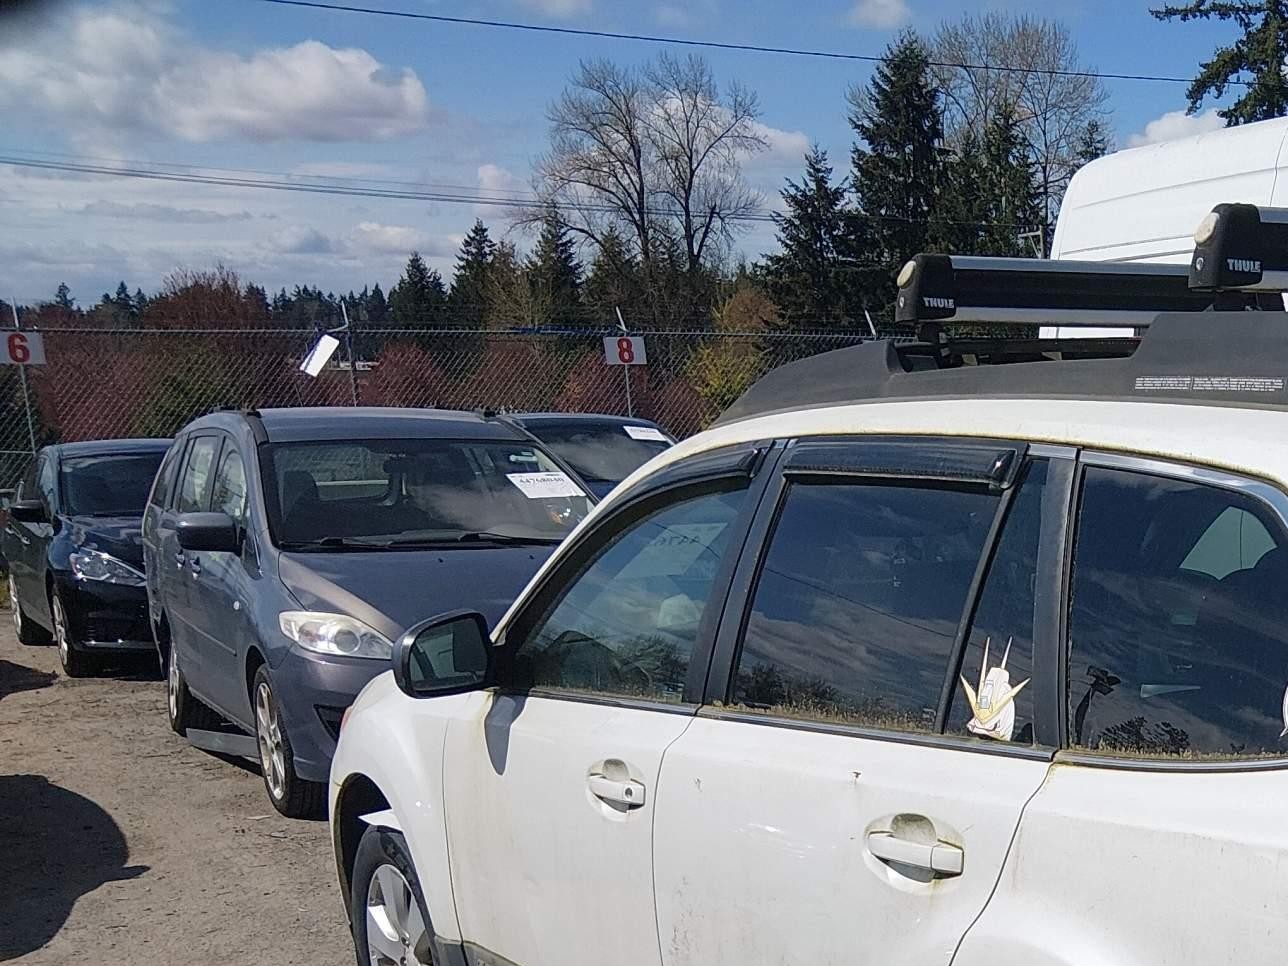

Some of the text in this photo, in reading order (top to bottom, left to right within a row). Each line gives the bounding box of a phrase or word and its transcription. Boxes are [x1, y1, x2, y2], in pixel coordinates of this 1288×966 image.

[1226, 258, 1261, 273] THULE
[923, 296, 955, 309] THULE
[8, 333, 30, 363] 6
[617, 338, 634, 363] 8
